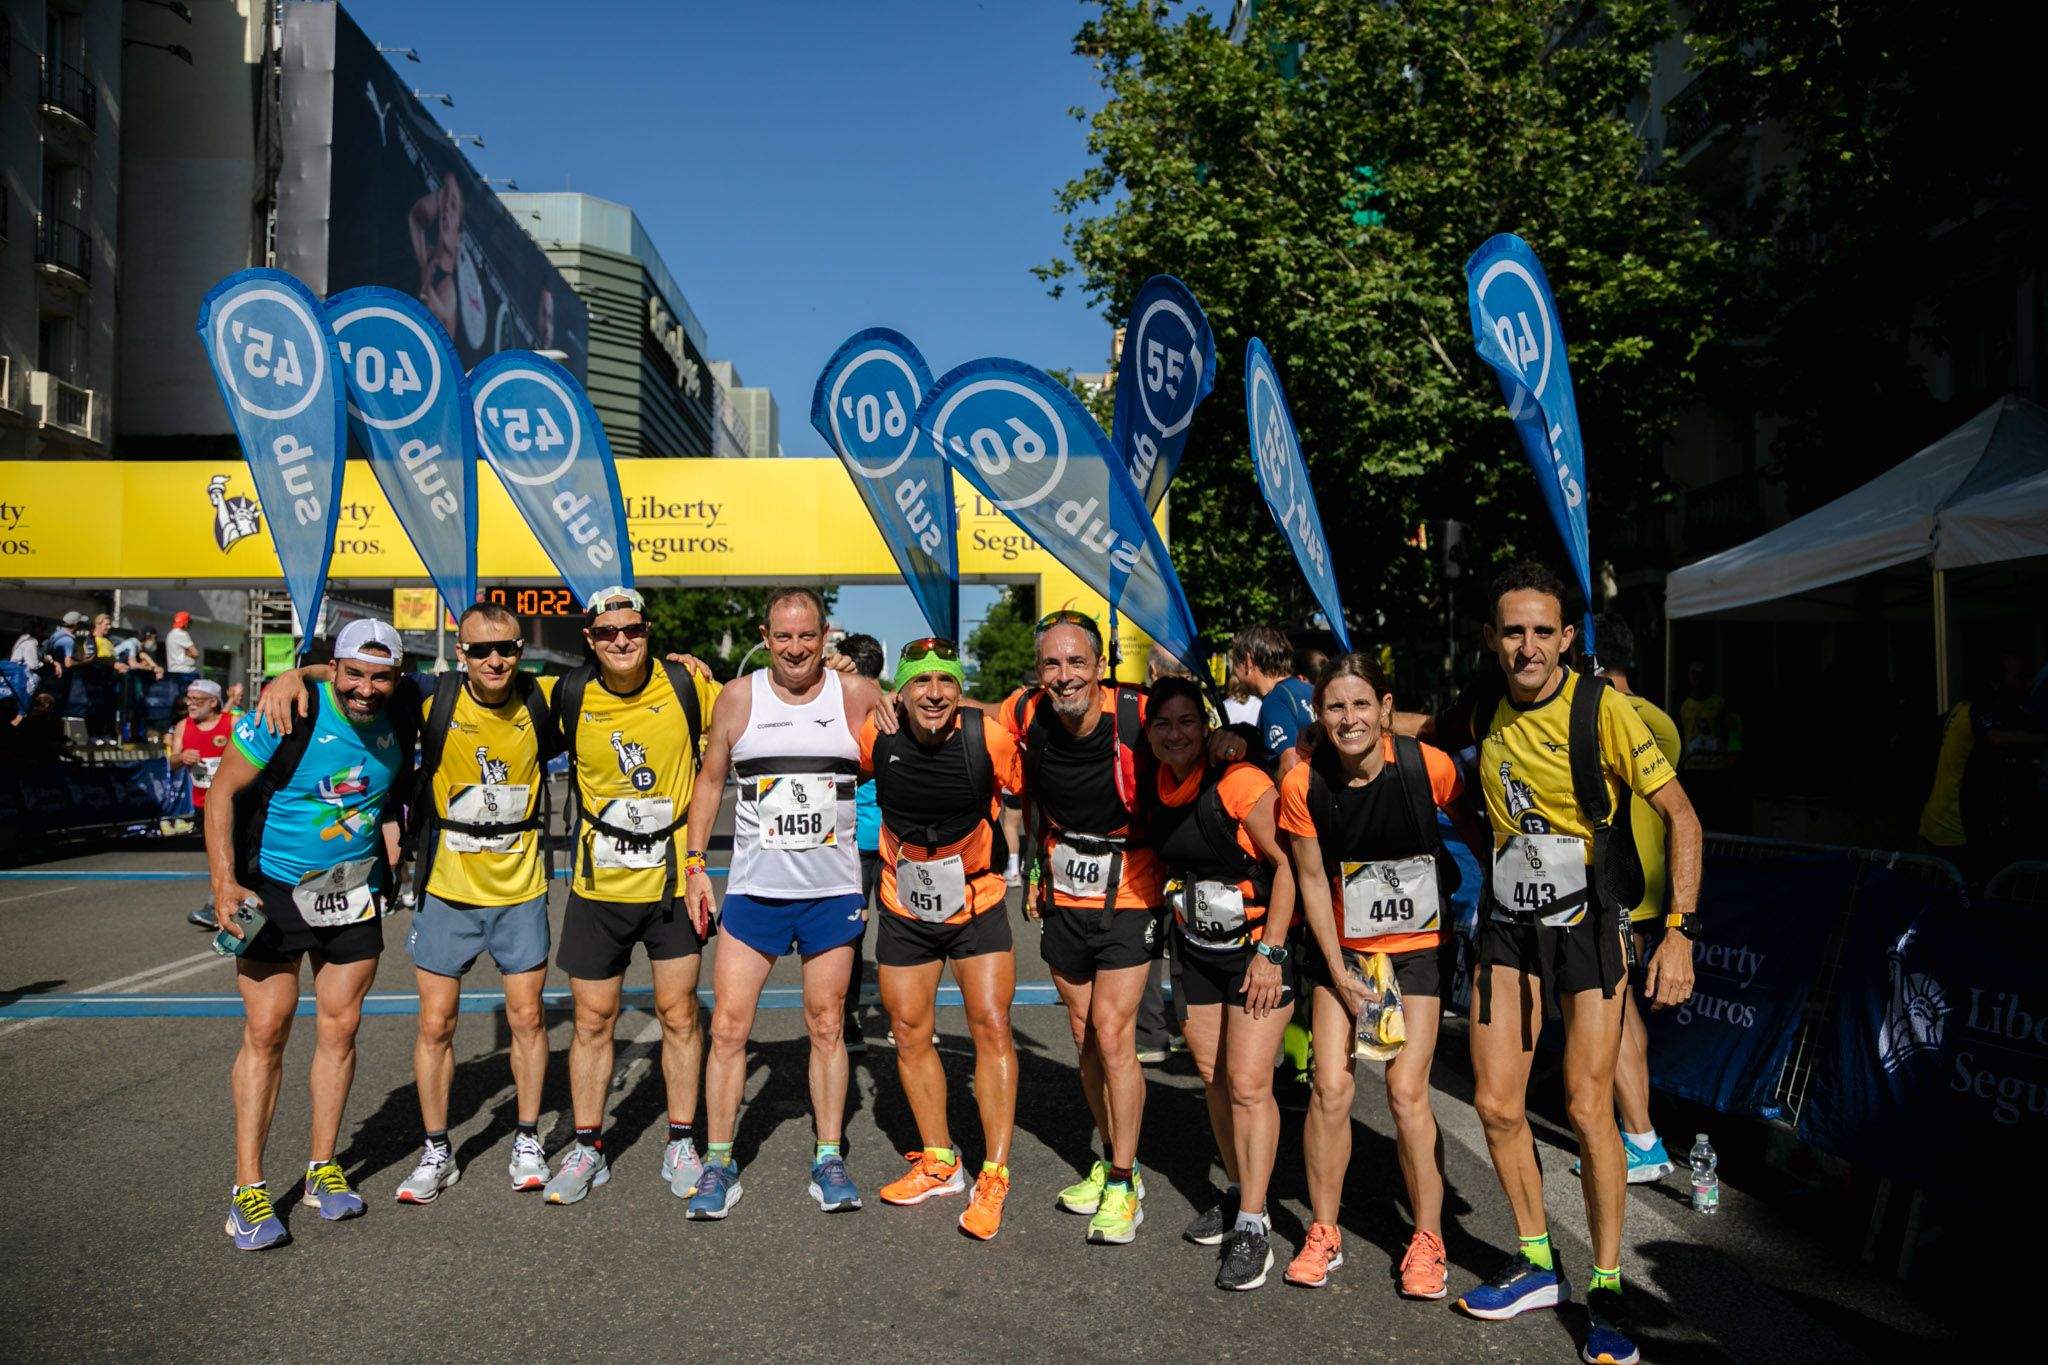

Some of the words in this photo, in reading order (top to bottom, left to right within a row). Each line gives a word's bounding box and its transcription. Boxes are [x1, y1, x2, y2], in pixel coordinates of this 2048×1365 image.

[1129, 430, 1158, 491] ub
[625, 495, 723, 529] Liberty
[973, 528, 1043, 561] Segu
[635, 771, 653, 787] 13
[774, 812, 823, 836] 1458
[1524, 818, 1545, 834] 13
[1065, 859, 1100, 884] 448
[314, 890, 350, 915] 445
[910, 890, 943, 912] 451
[1513, 881, 1557, 909] 443
[1369, 897, 1415, 923] 449
[1693, 939, 1766, 989] berty
[1677, 991, 1758, 1028] guros
[1966, 984, 2048, 1047] Libe
[1950, 1047, 2048, 1128] Segu
